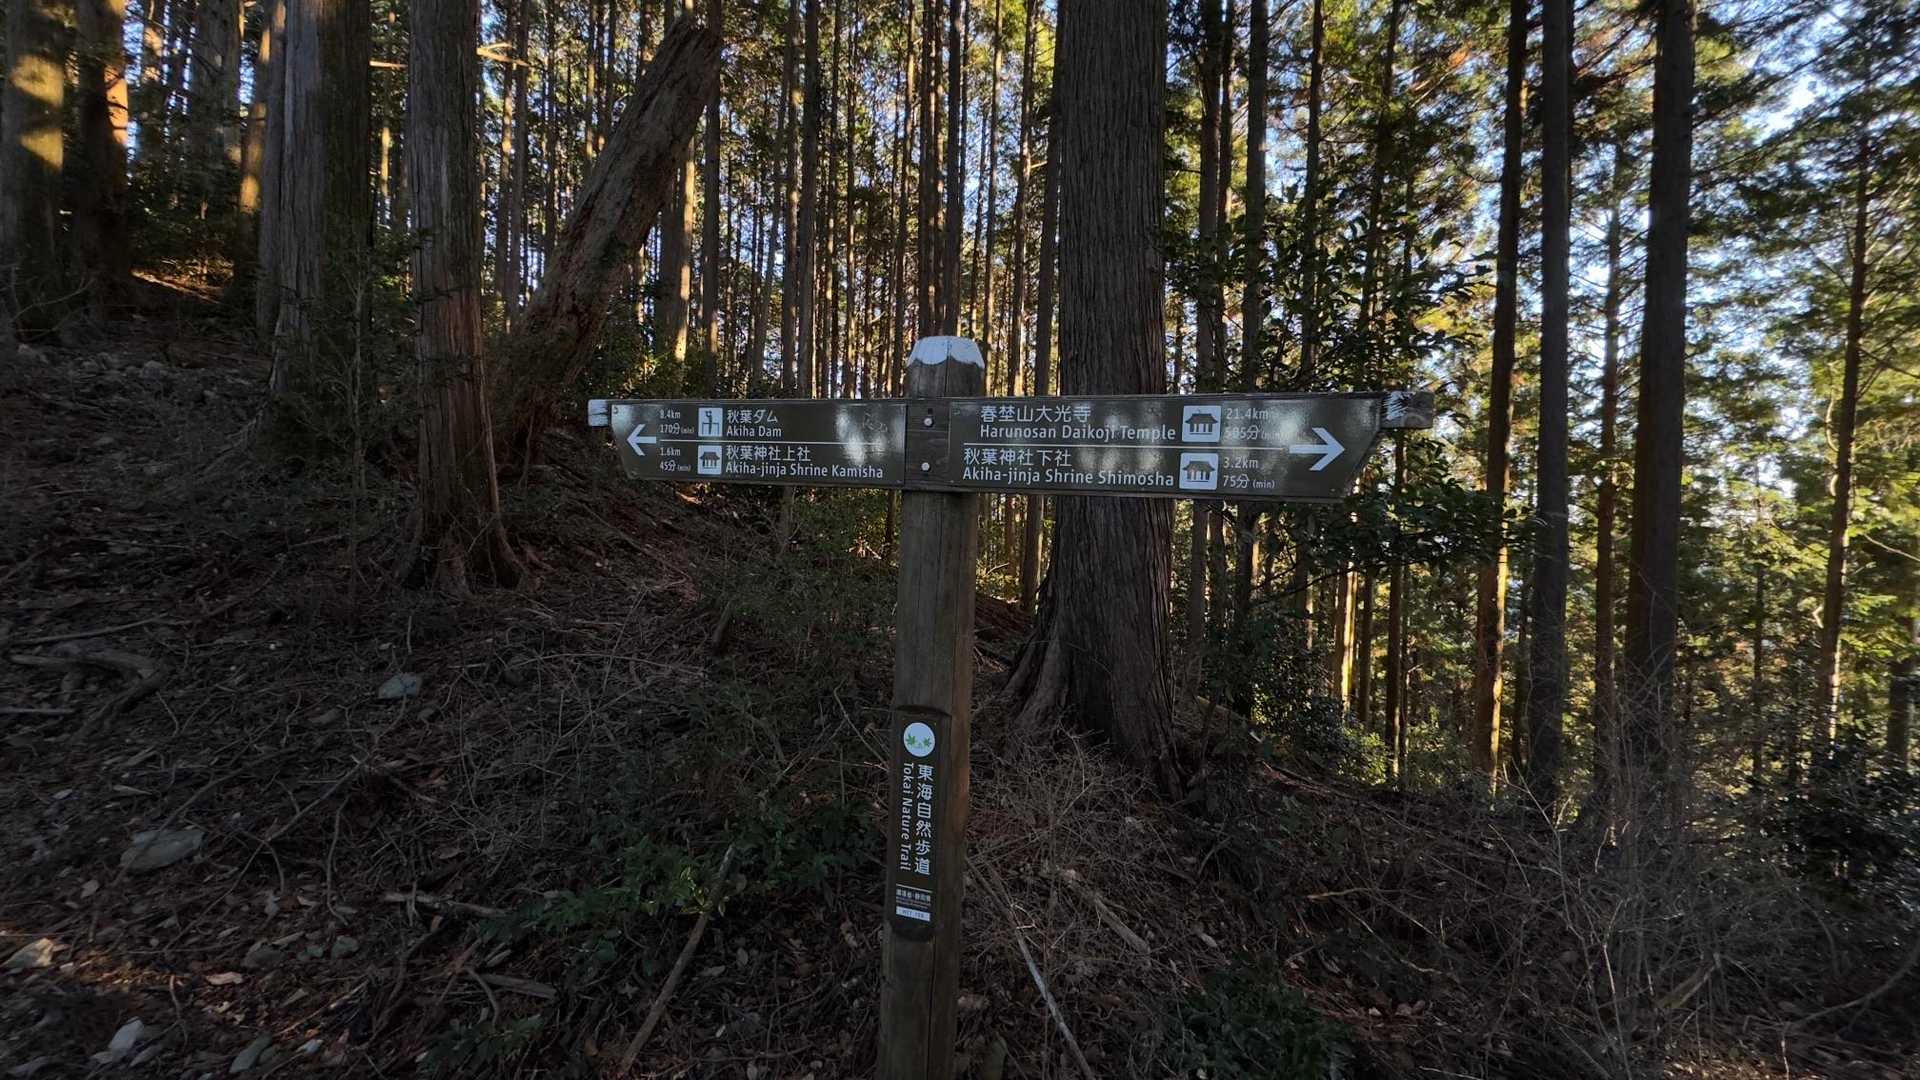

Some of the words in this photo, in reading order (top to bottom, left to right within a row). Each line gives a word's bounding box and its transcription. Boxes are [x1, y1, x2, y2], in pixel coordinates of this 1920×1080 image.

[726, 409, 779, 424] 秋葉ダム
[980, 404, 1092, 423] 春埜山大光寺
[1226, 407, 1269, 420] 21.4km
[726, 425, 755, 438] Akiha
[758, 425, 782, 438] Dam
[980, 424, 1057, 440] Harunosan
[1062, 424, 1116, 442] Daikoji
[1120, 425, 1176, 442] Temple
[726, 445, 812, 462] 秋葉神社上社
[964, 448, 1072, 467] 秋葉神社下社
[1223, 456, 1259, 469] 3.2km
[725, 461, 787, 478] Akiha-jinja
[790, 463, 828, 477] Shrine
[831, 464, 884, 479] Kamisha
[963, 466, 1041, 484] Akiha-jinja
[1045, 468, 1094, 484] Shrine
[1098, 469, 1175, 487] Shimosha
[1223, 474, 1250, 489] 75分
[903, 762, 915, 794] Tokai
[901, 797, 913, 840] Nature
[914, 763, 935, 876] 東海自然歩道
[900, 843, 912, 872] Trail
